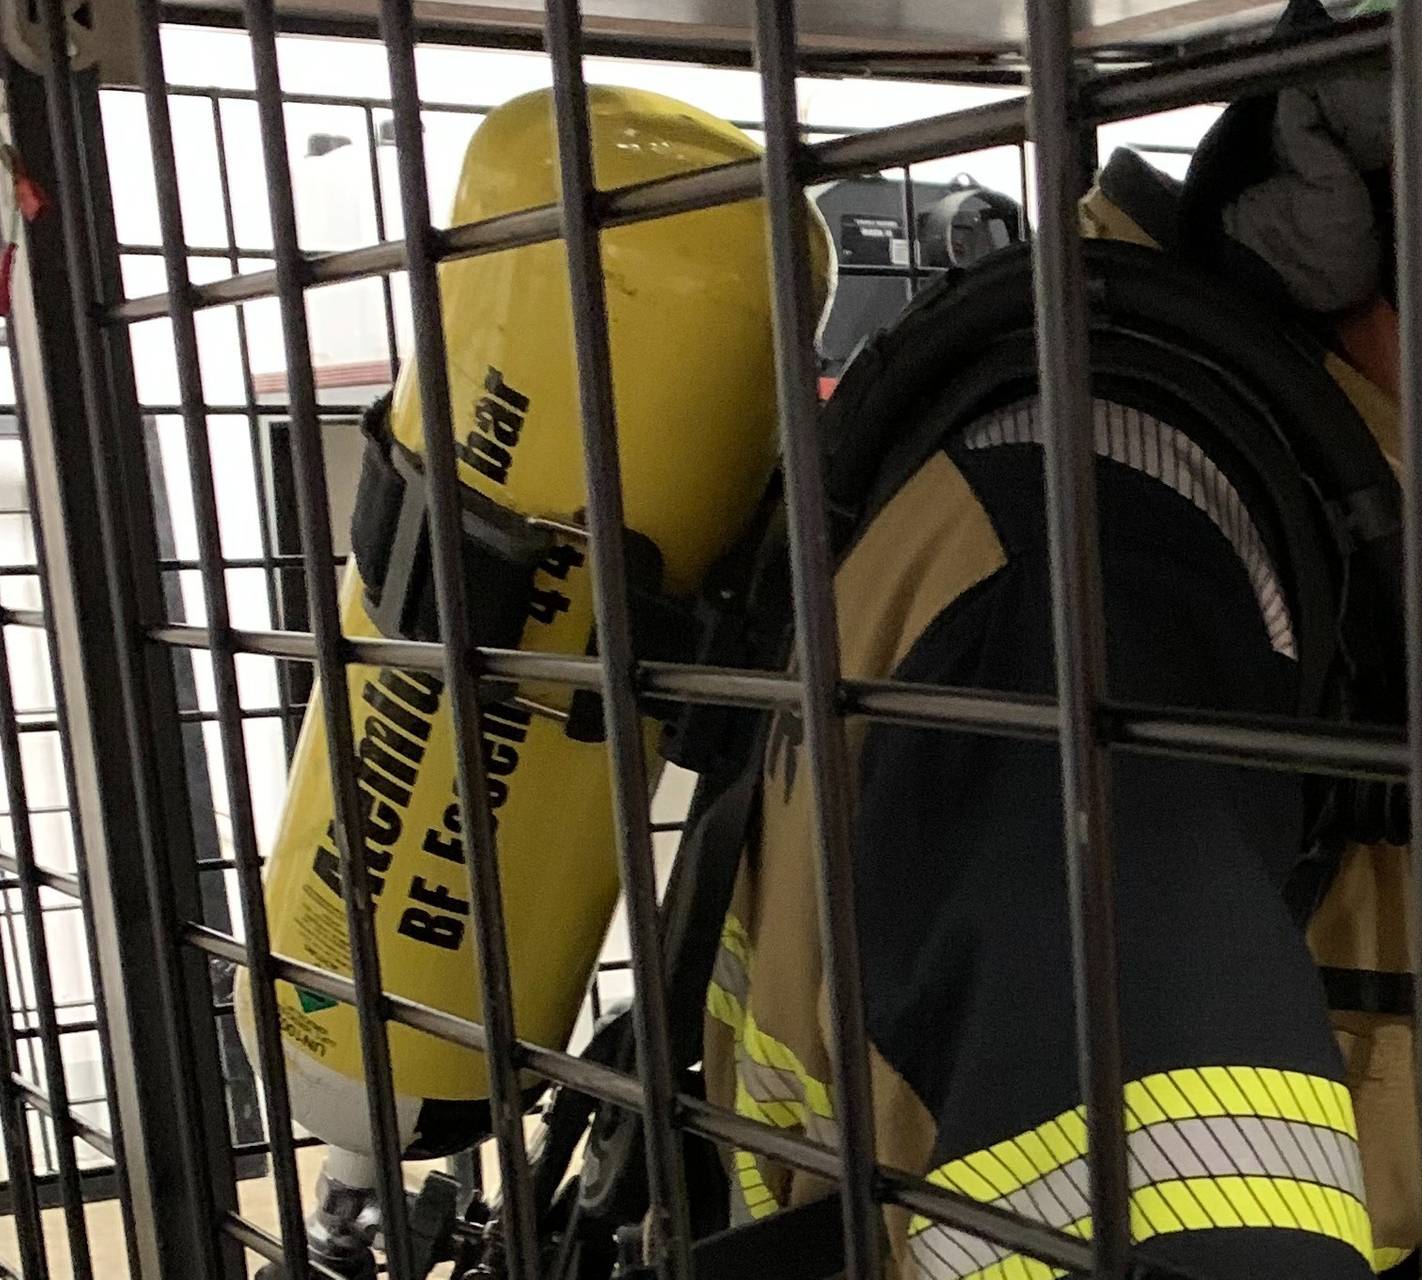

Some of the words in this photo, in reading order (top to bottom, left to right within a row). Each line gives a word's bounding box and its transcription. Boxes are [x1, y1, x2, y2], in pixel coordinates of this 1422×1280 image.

[312, 668, 444, 912] Atemlu
[455, 364, 531, 485] bar
[398, 876, 470, 950] BF
